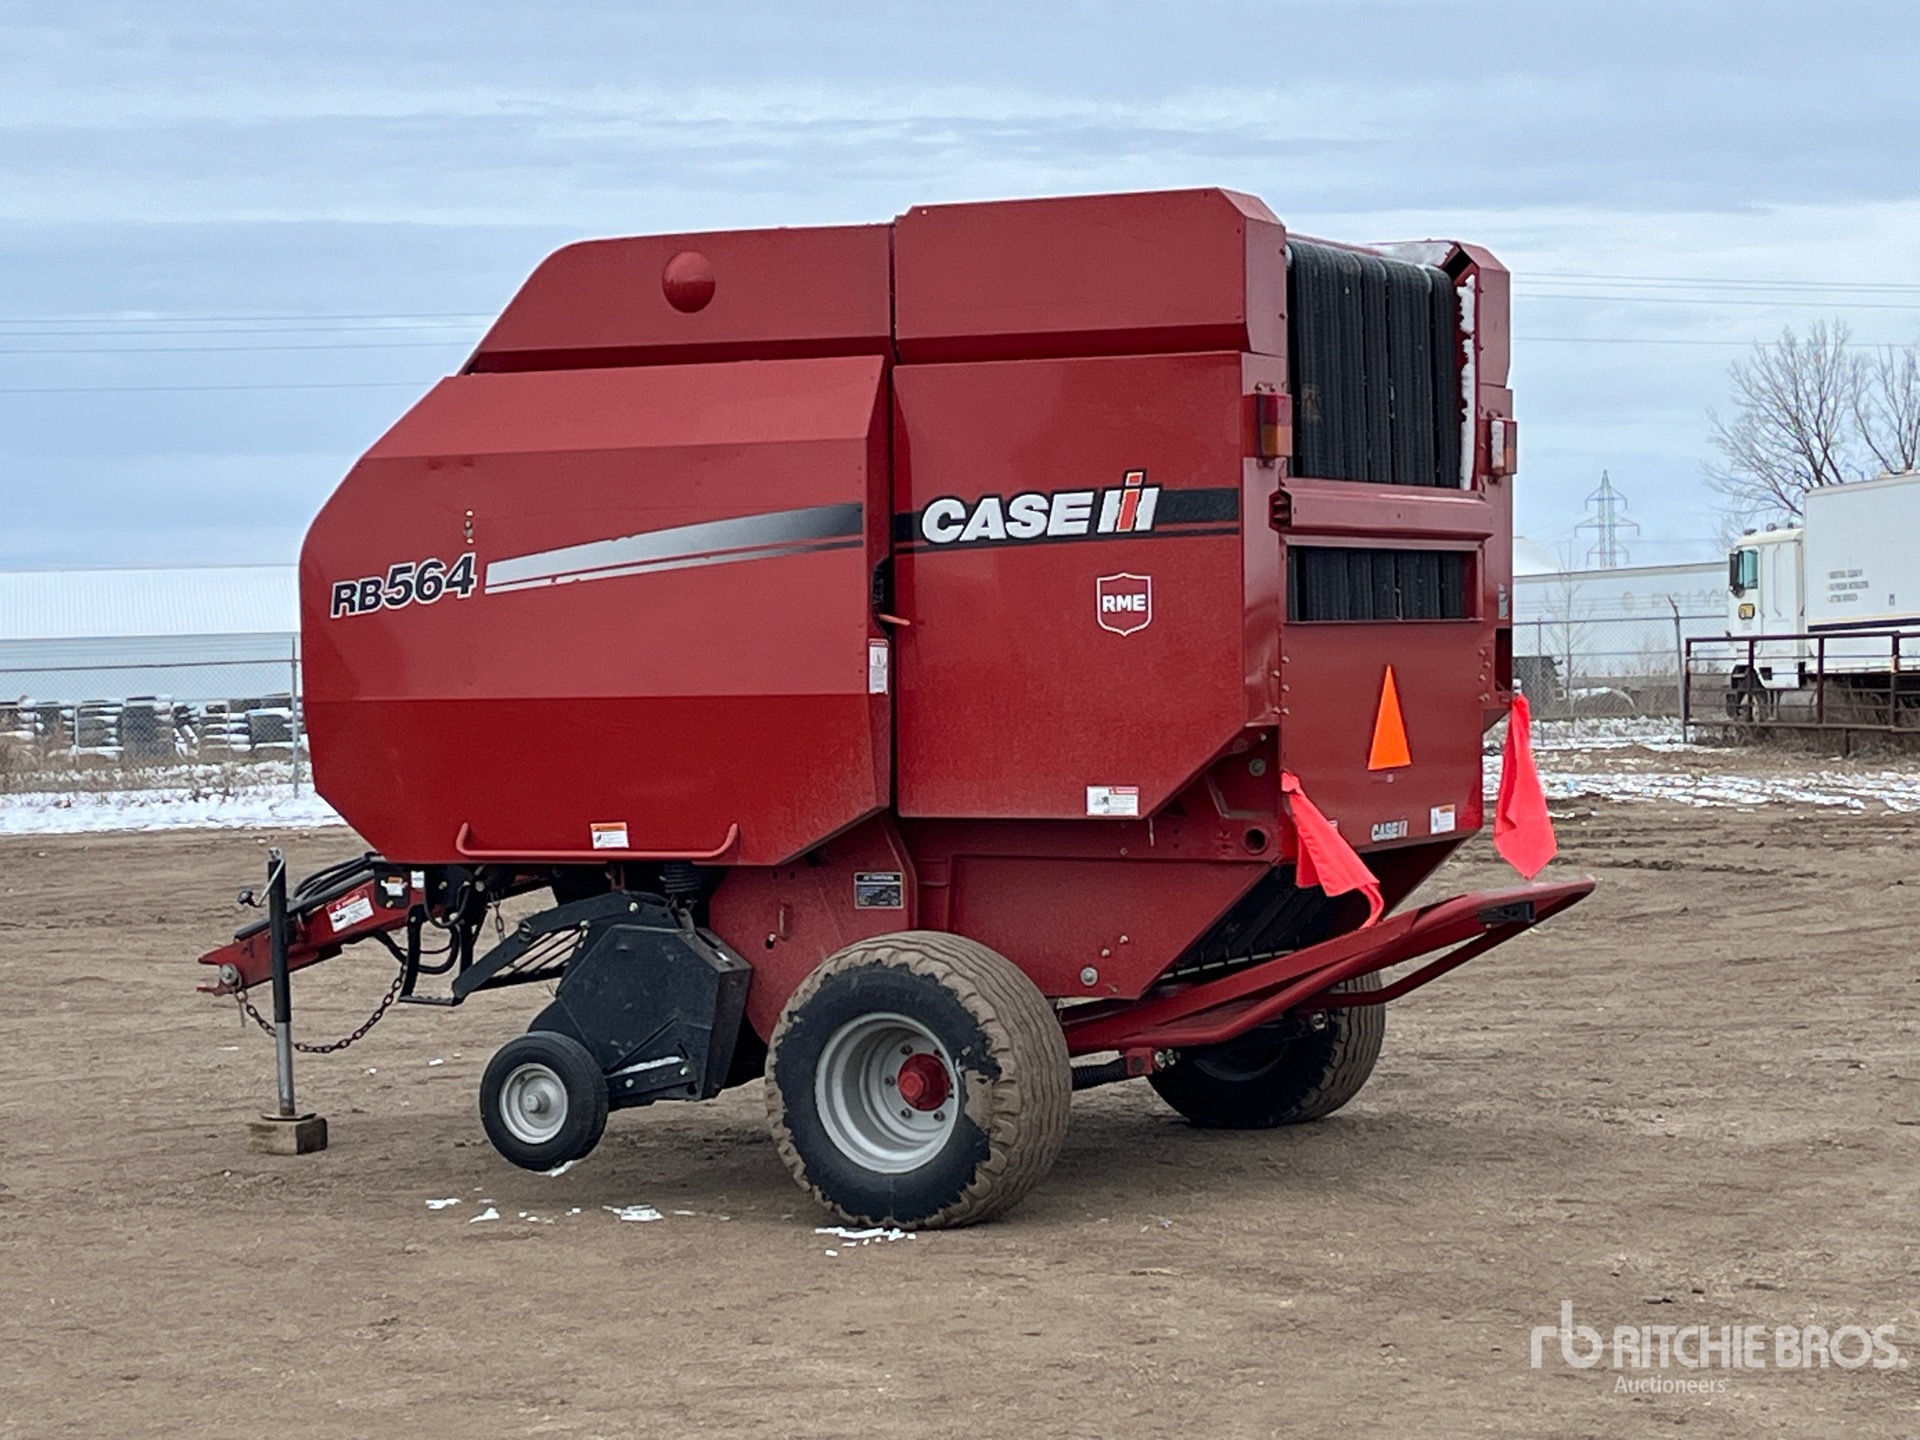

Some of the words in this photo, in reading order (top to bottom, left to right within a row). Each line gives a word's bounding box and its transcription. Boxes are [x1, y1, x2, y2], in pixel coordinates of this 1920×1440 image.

[921, 491, 1095, 543] CASE
[330, 552, 478, 619] RB564
[1102, 593, 1146, 612] RME
